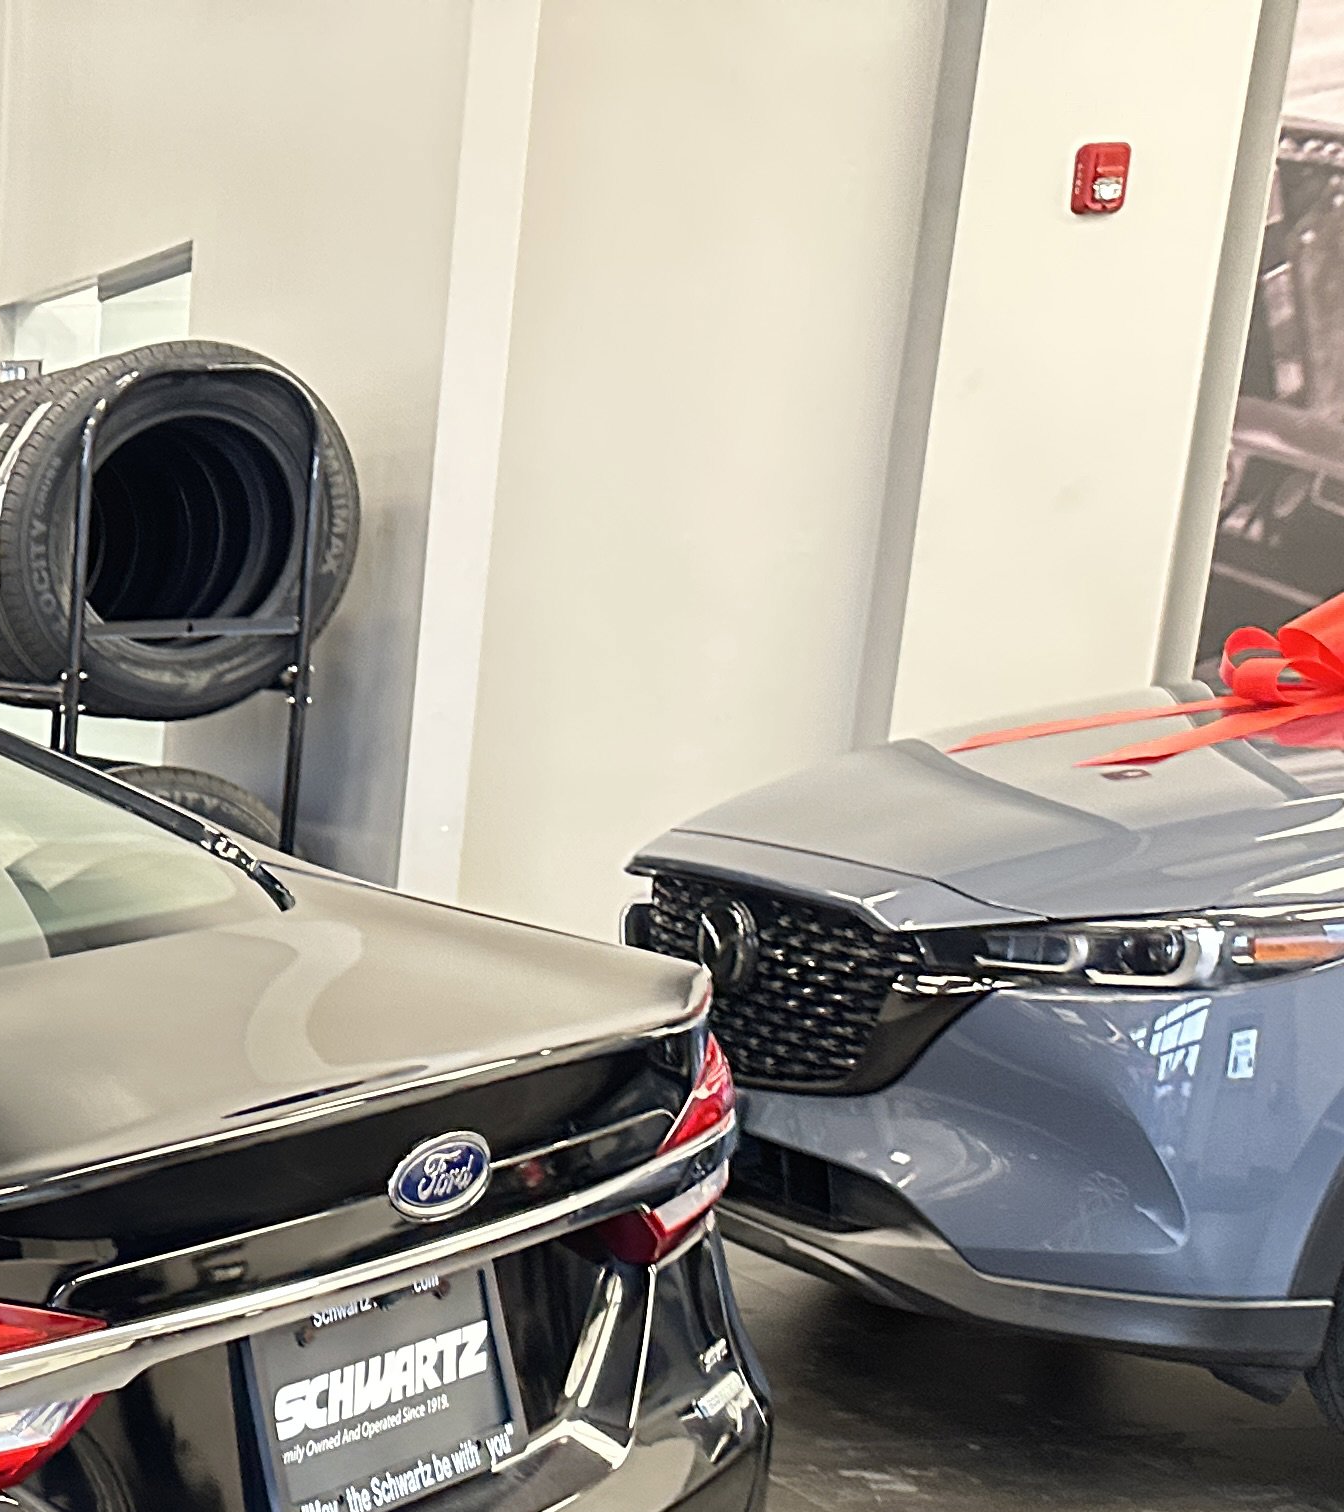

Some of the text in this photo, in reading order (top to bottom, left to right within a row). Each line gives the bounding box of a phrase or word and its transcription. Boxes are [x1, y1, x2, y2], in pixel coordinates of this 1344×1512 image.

[417, 1150, 474, 1201] Ford
[274, 1319, 488, 1441] SCHWARTZ
[282, 1442, 305, 1465] mily
[306, 1432, 341, 1457] Owned
[341, 1422, 361, 1447] And
[361, 1411, 402, 1440] Operated
[402, 1403, 426, 1425] Since
[370, 1460, 434, 1507] Schwartz
[433, 1450, 453, 1479] be
[453, 1441, 480, 1470] with
